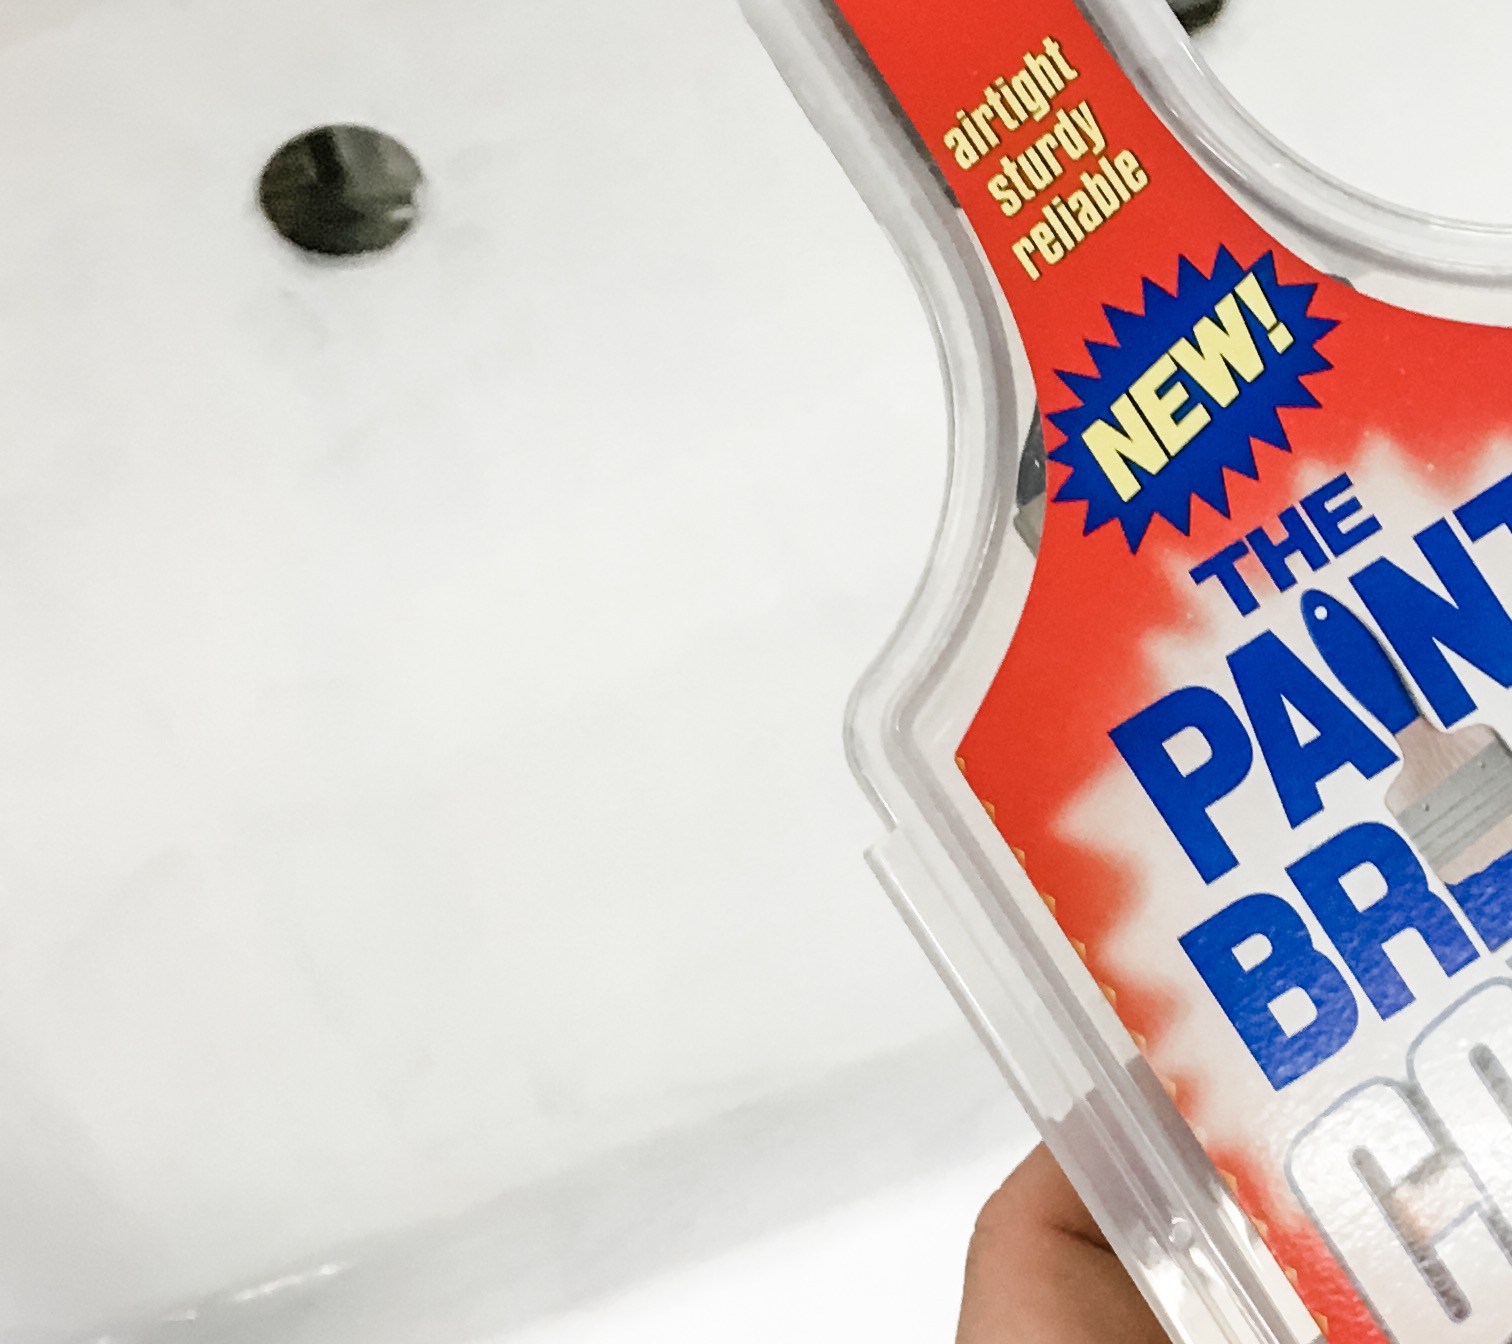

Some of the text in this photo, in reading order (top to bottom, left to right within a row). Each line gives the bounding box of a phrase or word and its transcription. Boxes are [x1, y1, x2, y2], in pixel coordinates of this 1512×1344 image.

[943, 35, 1080, 170] airtight
[987, 101, 1107, 216] sturdy
[1012, 149, 1149, 281] reliable
[1081, 272, 1294, 502] NEW!
[1189, 472, 1383, 617] THE
